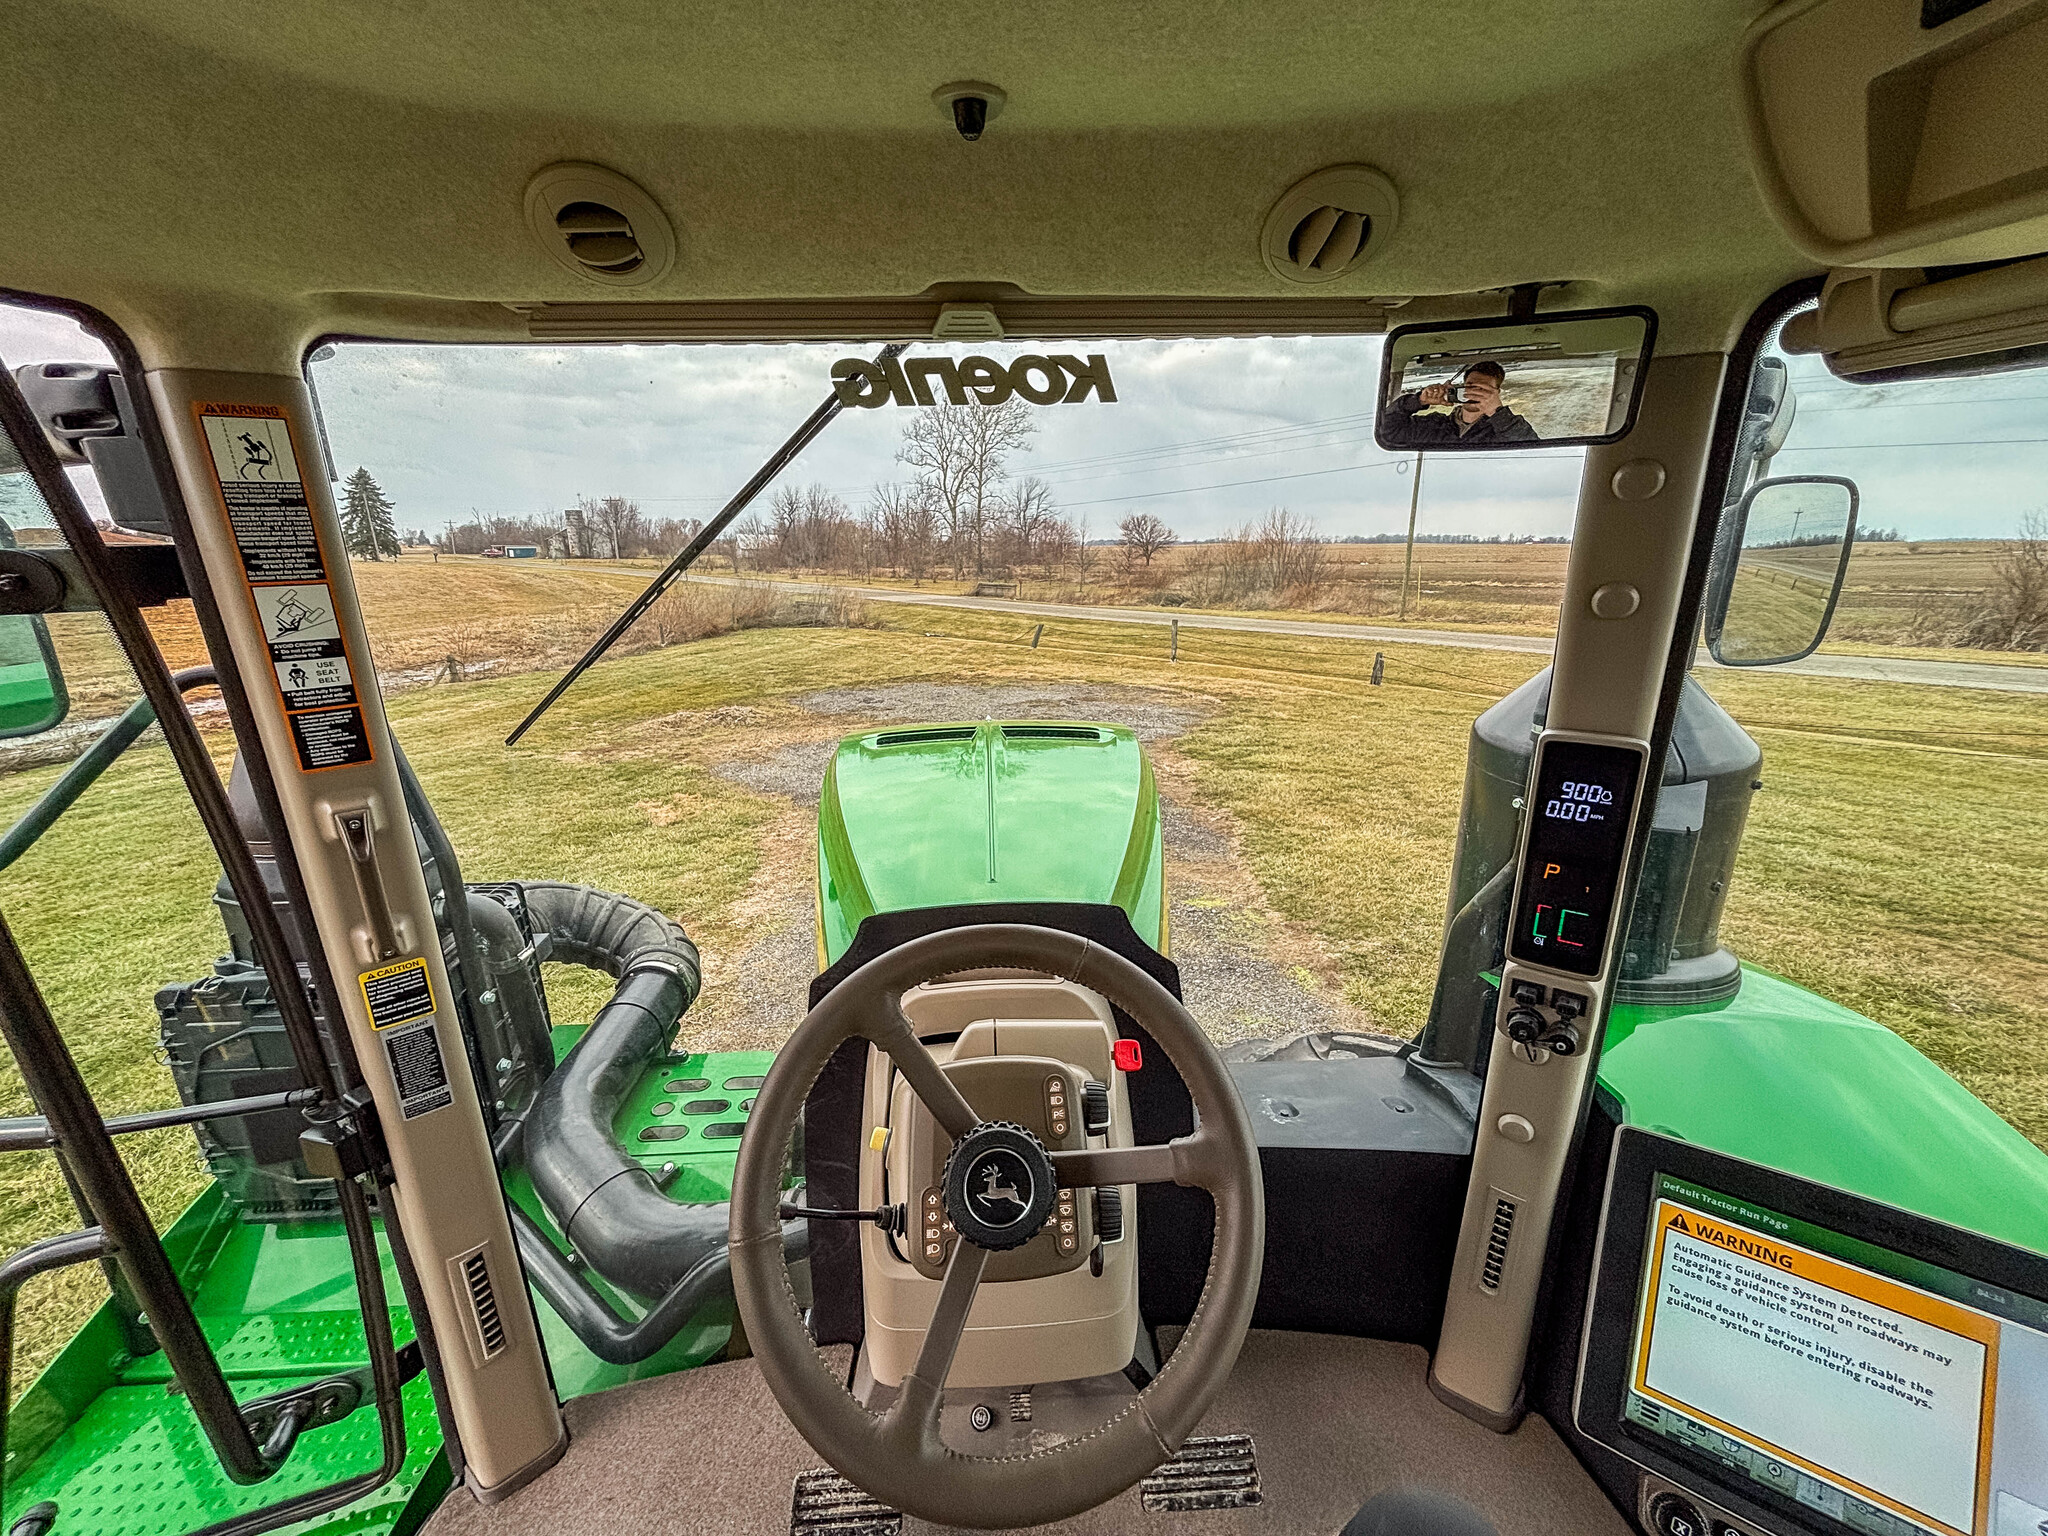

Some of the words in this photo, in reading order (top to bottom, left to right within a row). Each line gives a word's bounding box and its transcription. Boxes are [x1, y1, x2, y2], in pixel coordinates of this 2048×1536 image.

[216, 403, 279, 416] WARNING
[316, 661, 335, 669] USE
[316, 668, 340, 677] SEAT
[318, 676, 341, 684] BELT
[1561, 781, 1603, 803] 900
[1546, 800, 1591, 822] 0.00
[1543, 863, 1561, 879] P
[376, 960, 420, 978] CAUTION
[387, 1019, 429, 1037] IMPORTANT
[406, 1087, 446, 1104] IMPORTANT
[1662, 1181, 1700, 1200] Default
[1702, 1194, 1738, 1212] Tractor
[1739, 1207, 1760, 1221] Run
[1763, 1215, 1789, 1230] Page
[1696, 1223, 1793, 1269] WARNING
[1671, 1264, 1703, 1281] cause
[1706, 1276, 1728, 1291] loss
[1731, 1287, 1744, 1297] of
[1746, 1293, 1787, 1314] vehicle
[1790, 1311, 1839, 1334] control.
[1674, 1242, 1732, 1270] Automatic
[1735, 1267, 1790, 1291] Guidance
[1792, 1287, 1837, 1310] System
[1841, 1304, 1903, 1334] Detected.
[1673, 1252, 1722, 1279] Engaging
[1725, 1273, 1731, 1281] a
[1734, 1276, 1787, 1302] guidance
[1790, 1299, 1834, 1320] system
[1837, 1317, 1853, 1328] on
[1857, 1323, 1919, 1353] roadways
[1923, 1349, 1952, 1366] may
[1668, 1283, 1680, 1295] To
[1683, 1291, 1712, 1308] avoid
[1715, 1303, 1748, 1323] death
[1752, 1320, 1765, 1328] or
[1768, 1325, 1812, 1348] serious
[1816, 1342, 1855, 1366] injury,
[1859, 1360, 1906, 1386] disable
[1910, 1380, 1934, 1397] the
[1666, 1296, 1717, 1321] guidance
[1719, 1317, 1761, 1339] system
[1765, 1334, 1804, 1357] before
[1807, 1354, 1861, 1382] entering
[1865, 1375, 1933, 1410] roadways.
